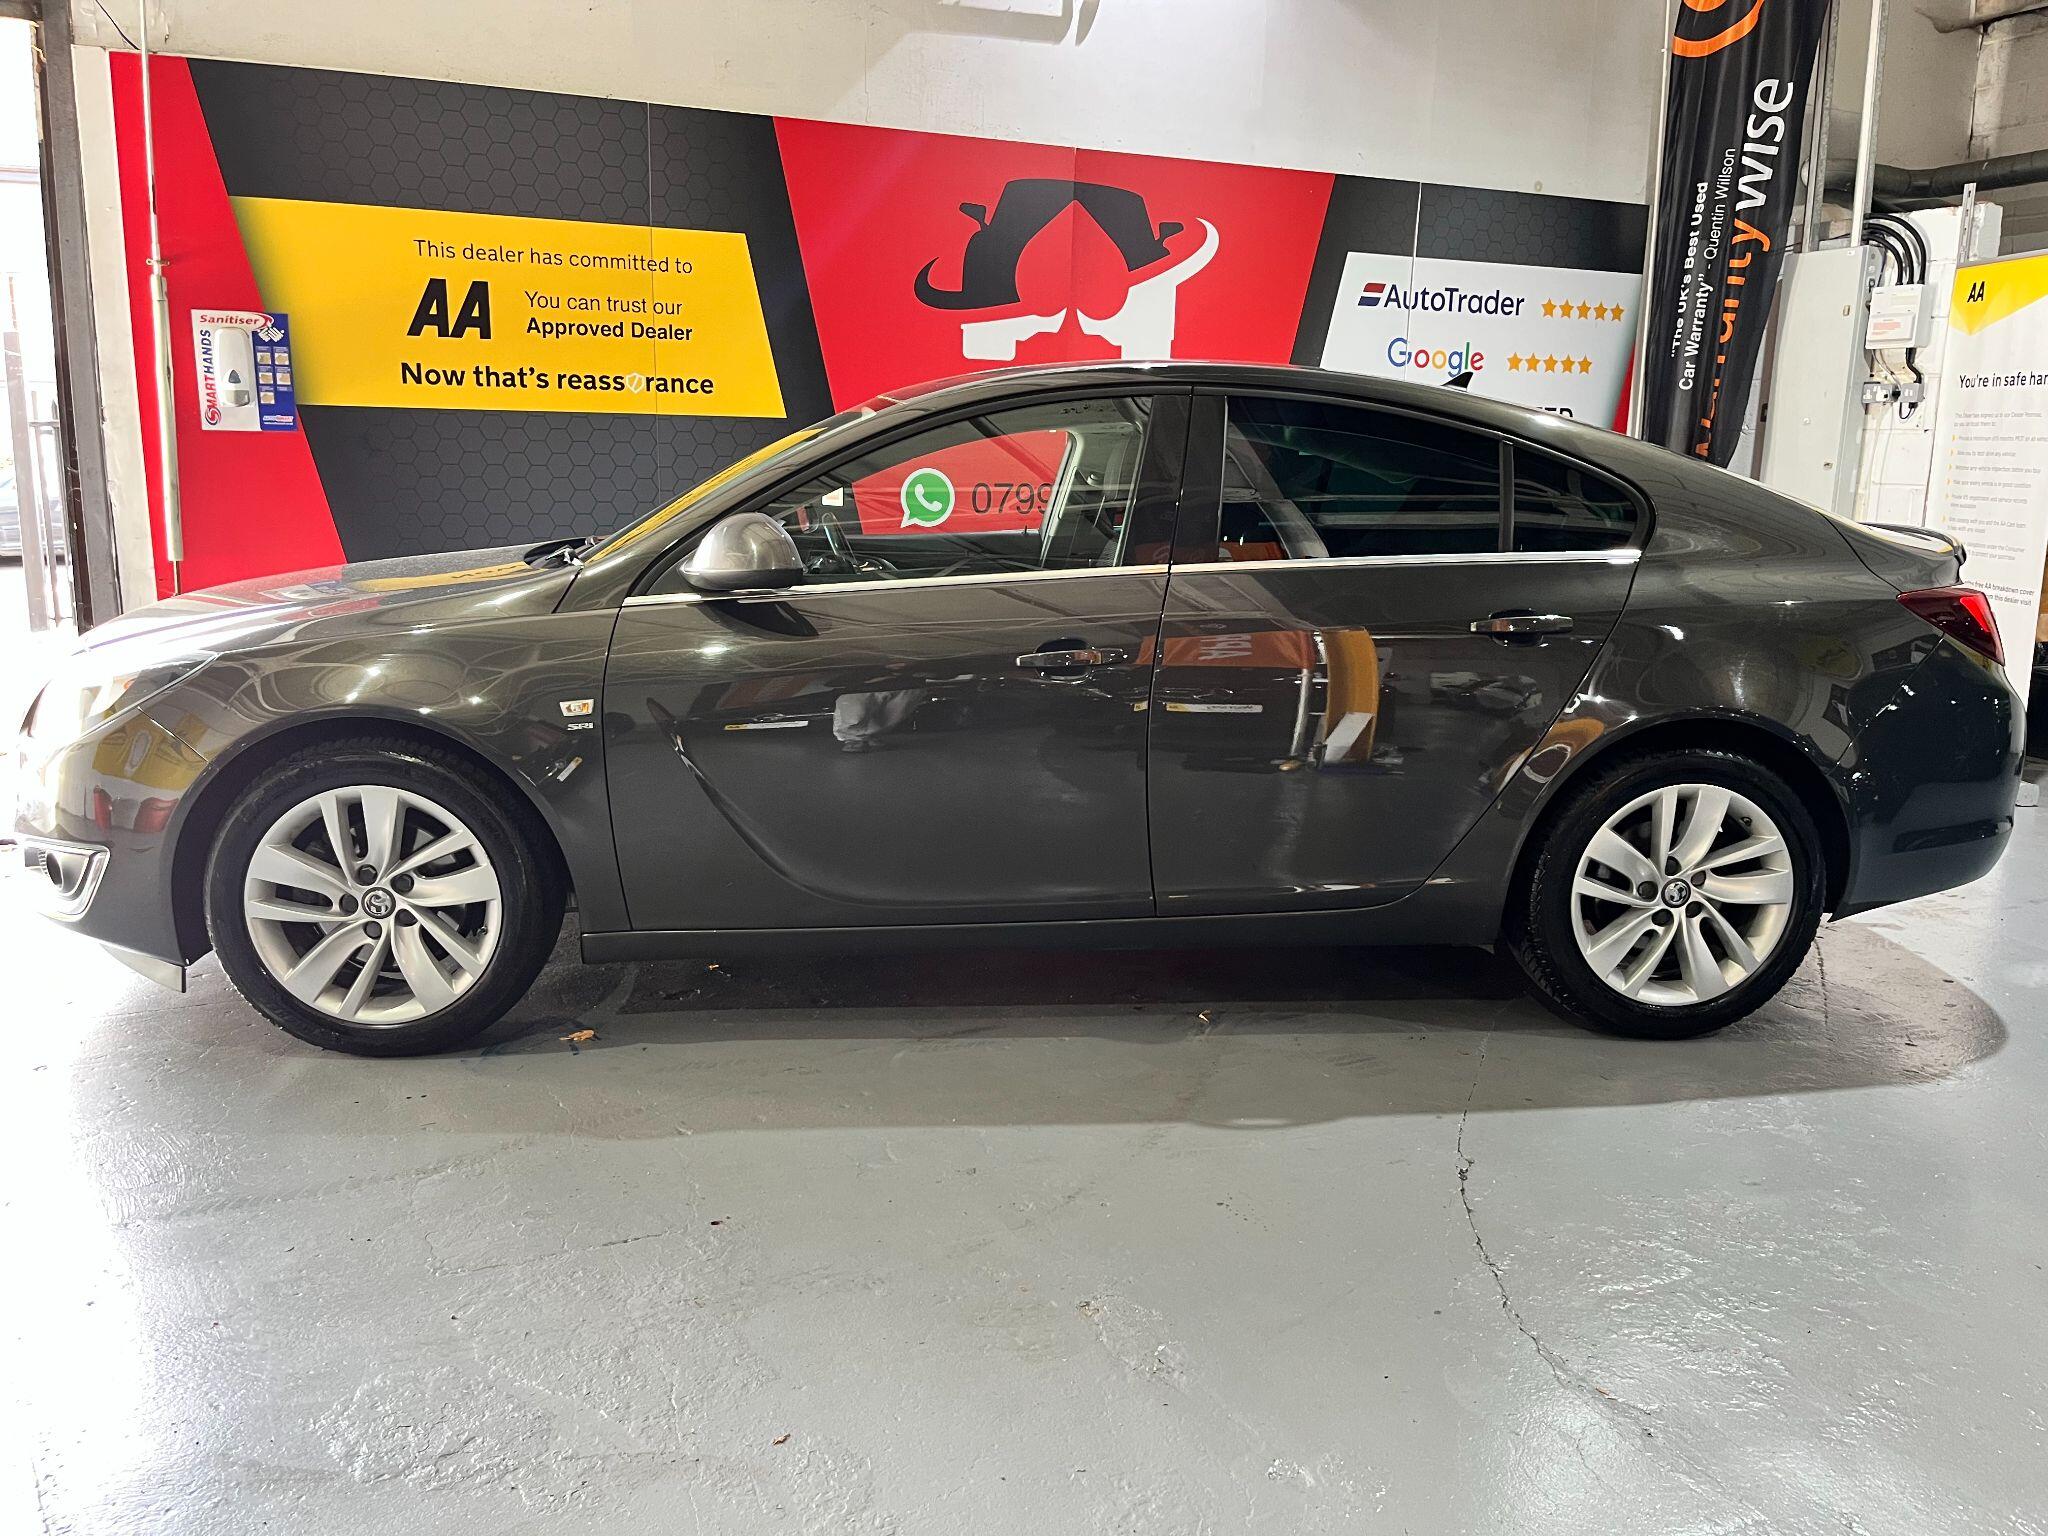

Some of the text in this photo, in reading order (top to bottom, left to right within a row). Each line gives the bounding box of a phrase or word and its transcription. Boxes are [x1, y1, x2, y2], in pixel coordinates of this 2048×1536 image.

[1691, 182, 1708, 225] Used
[413, 239, 693, 274] This dealer has committed to
[1684, 229, 1700, 269] Best
[1679, 360, 1696, 390] Car
[1703, 204, 1725, 259] Quentin
[1714, 148, 1736, 199] Willson
[524, 290, 683, 316] You can trust our
[1384, 284, 1525, 316] AutoTrader
[1967, 281, 1985, 303] AA
[200, 314, 260, 325] Sanitiser
[406, 277, 492, 340] AA
[526, 317, 693, 341] Approved Dealer
[1387, 337, 1484, 378] Google
[401, 362, 466, 386] Now
[1959, 374, 1989, 388] You're
[1992, 373, 2001, 387] in
[2004, 372, 2026, 387] safe
[972, 482, 1054, 514] 0799
